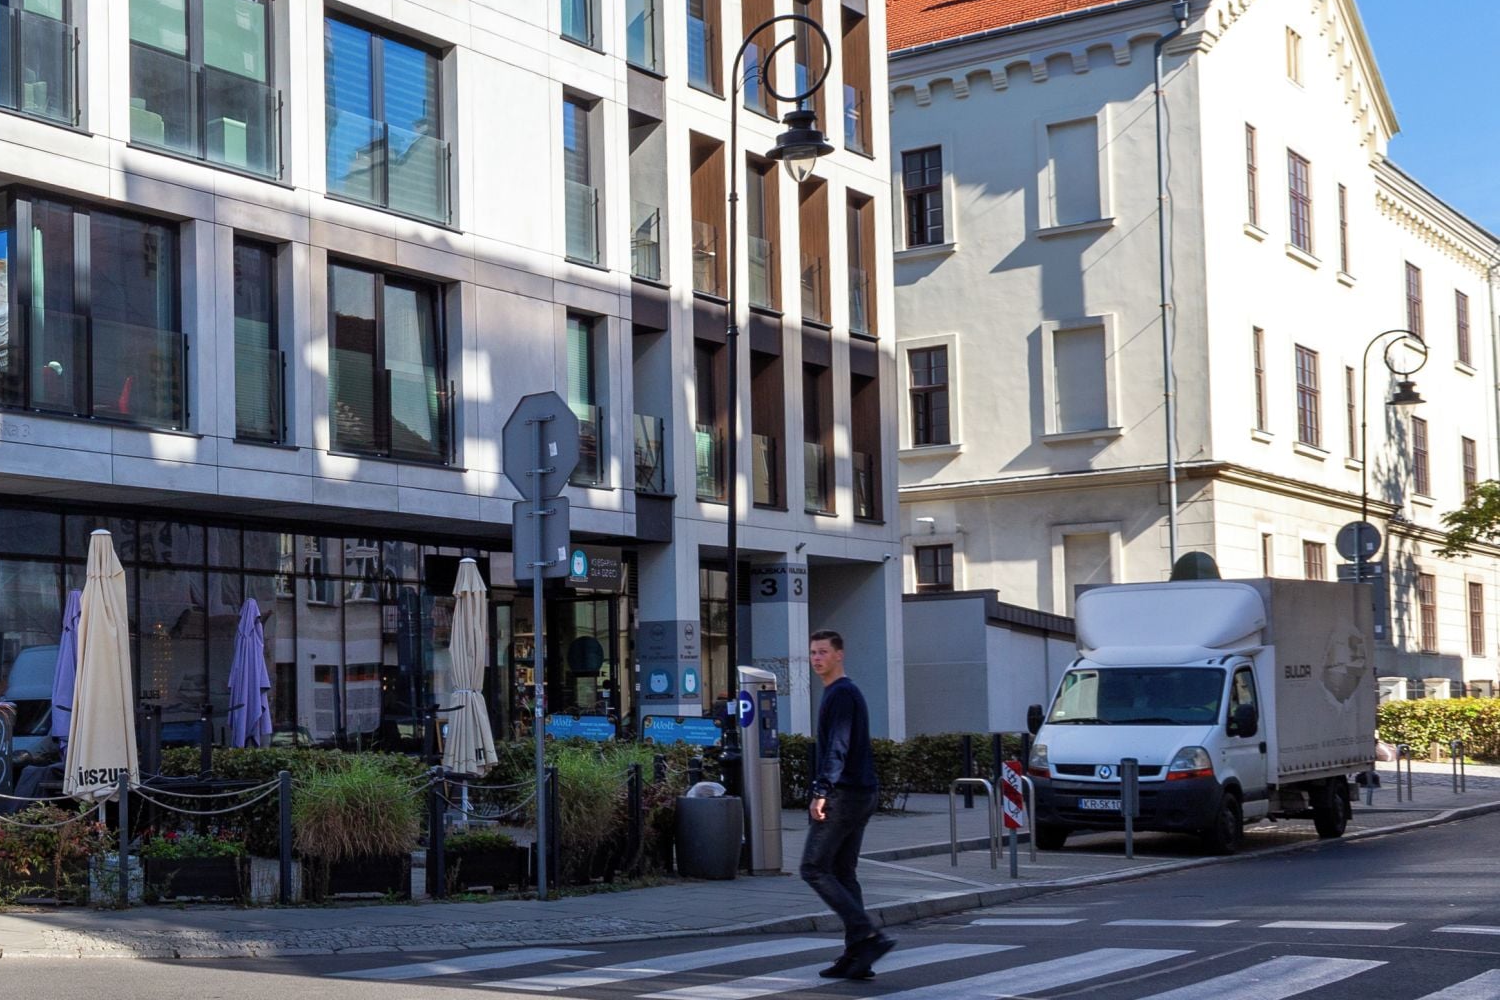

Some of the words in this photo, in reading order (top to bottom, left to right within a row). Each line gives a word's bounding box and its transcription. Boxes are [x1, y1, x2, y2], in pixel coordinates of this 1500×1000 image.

[760, 578, 778, 596] 3
[794, 578, 803, 596] 3
[740, 700, 752, 718] P
